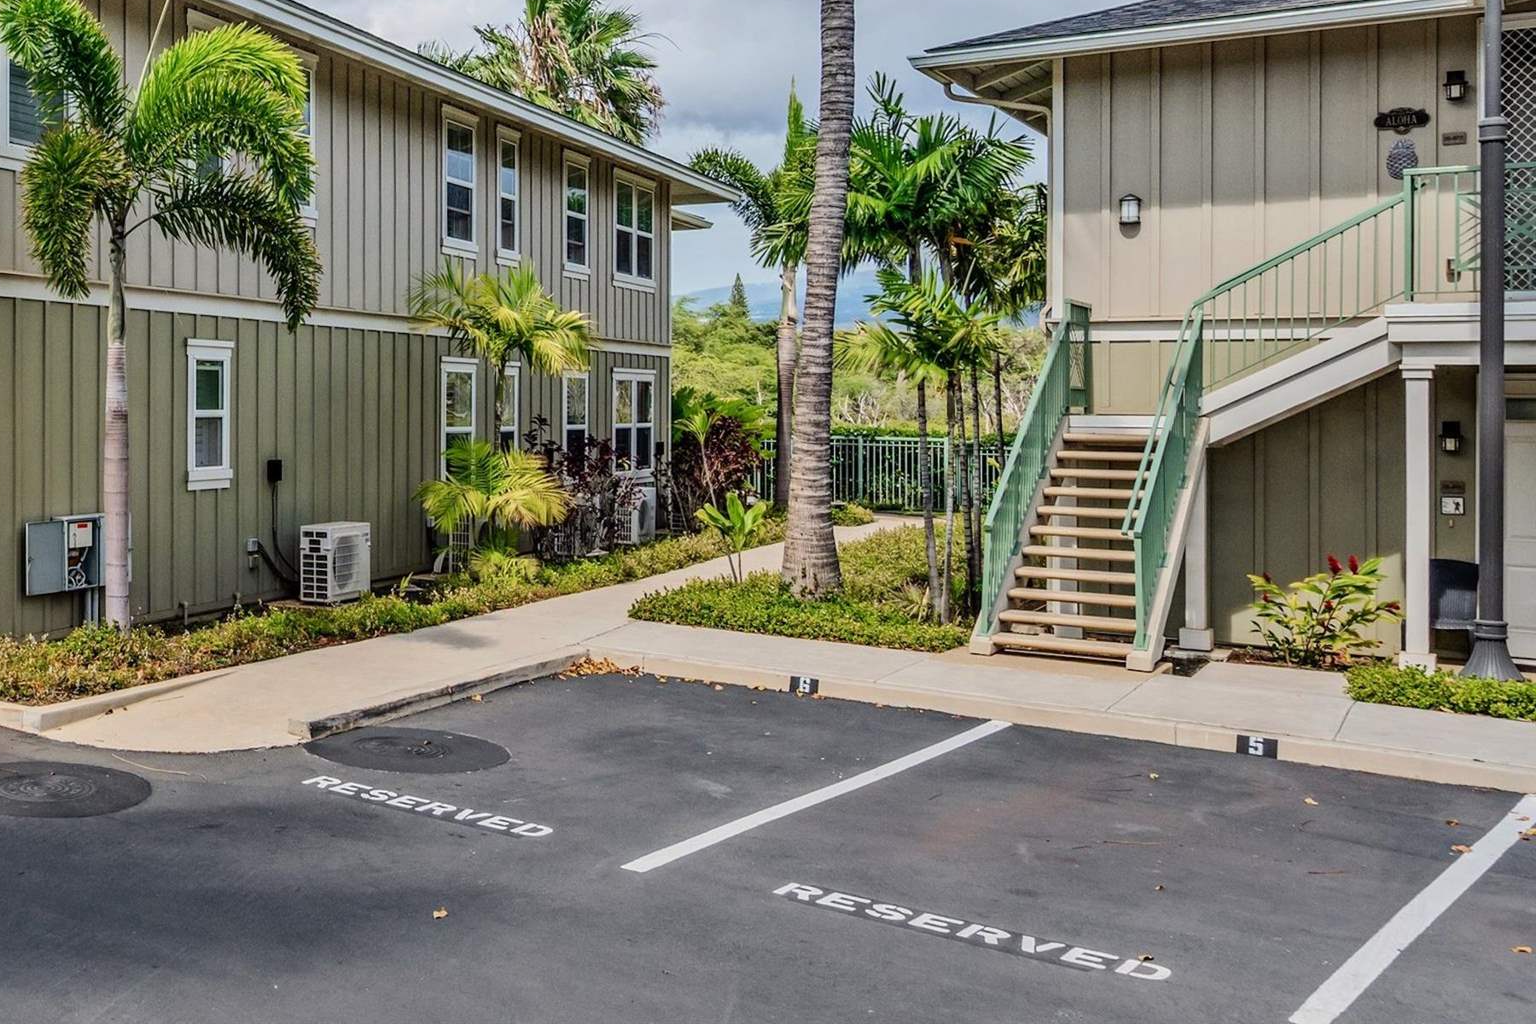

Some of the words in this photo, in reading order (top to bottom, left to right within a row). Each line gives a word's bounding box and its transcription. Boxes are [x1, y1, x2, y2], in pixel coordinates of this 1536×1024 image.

[1385, 114, 1417, 126] ALOHA
[799, 677, 811, 694] 6
[1248, 736, 1264, 756] 5
[302, 775, 554, 837] RESERVED
[772, 882, 1172, 980] RESERVED
